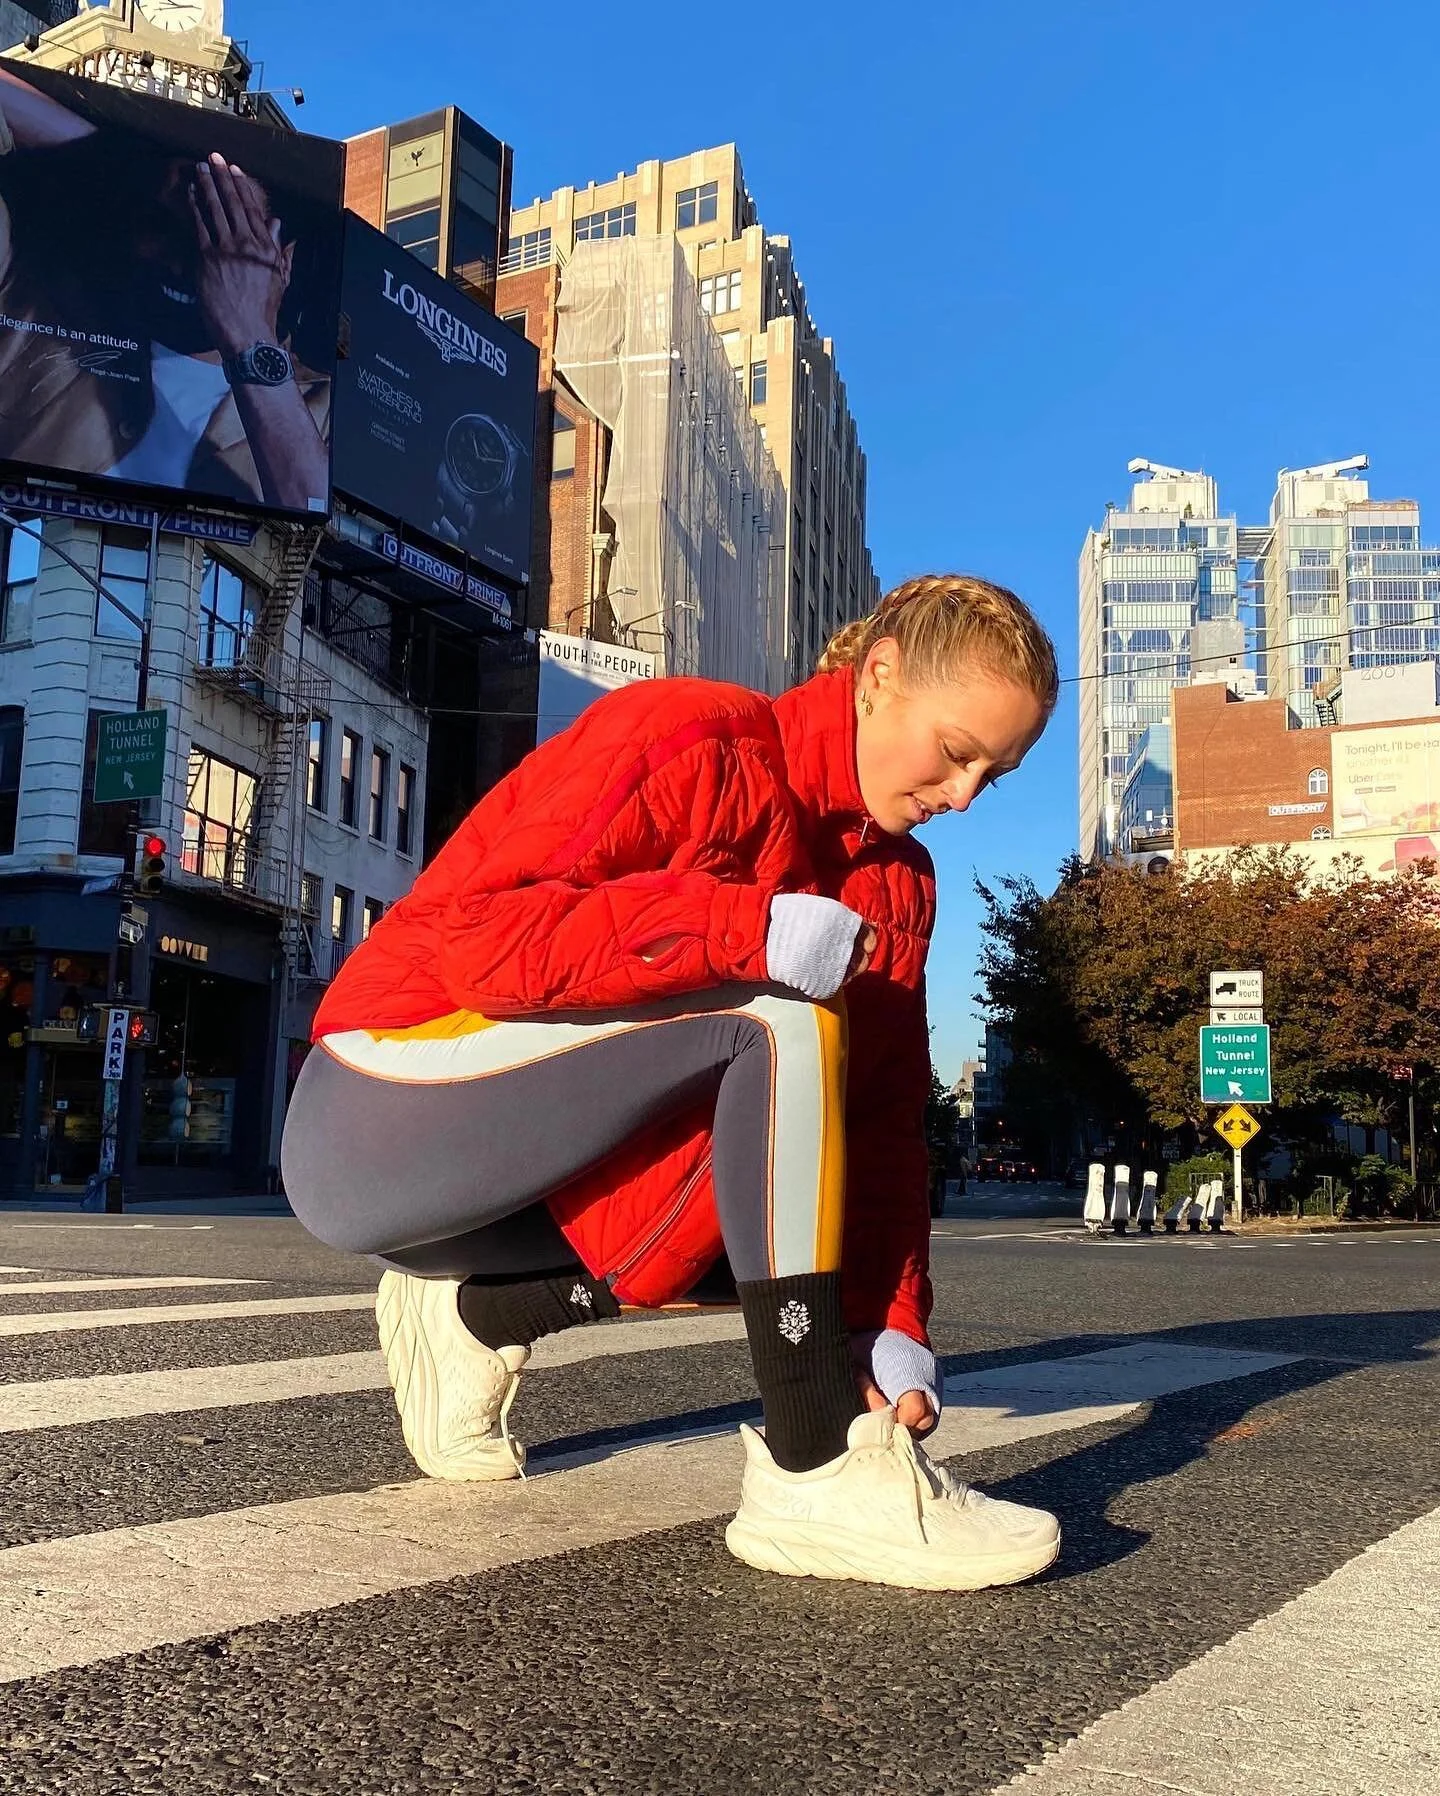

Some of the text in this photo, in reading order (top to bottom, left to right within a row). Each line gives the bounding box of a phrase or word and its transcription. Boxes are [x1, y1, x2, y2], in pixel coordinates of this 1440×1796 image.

[382, 269, 508, 377] LONGINES
[56, 325, 67, 337] is
[70, 330, 86, 342] an
[89, 333, 139, 351] attitude
[358, 365, 413, 409] WATCHES
[1, 483, 250, 542] OUTFRONT PRIME
[467, 577, 500, 607] PRIME
[545, 641, 588, 664] YOUTH
[593, 651, 600, 659] TO
[590, 658, 602, 667] THE
[604, 655, 651, 678] PEOPLE
[106, 716, 159, 734] HOLLAND
[110, 733, 154, 750] TUNNEL
[1345, 744, 1390, 756] Tonight,
[1392, 741, 1402, 751] I'll
[1405, 740, 1421, 750] be
[105, 752, 156, 765] NEW JERSEY
[1348, 775, 1374, 783] Uber
[1239, 979, 1260, 987] TRUCK
[1238, 990, 1260, 998] ROUTE
[1233, 1012, 1258, 1021] LOCAL
[109, 1012, 125, 1069] PARK
[1212, 1033, 1258, 1044] Holland
[1215, 1050, 1255, 1061] Tunnel
[1205, 1066, 1265, 1076] New Jersey
